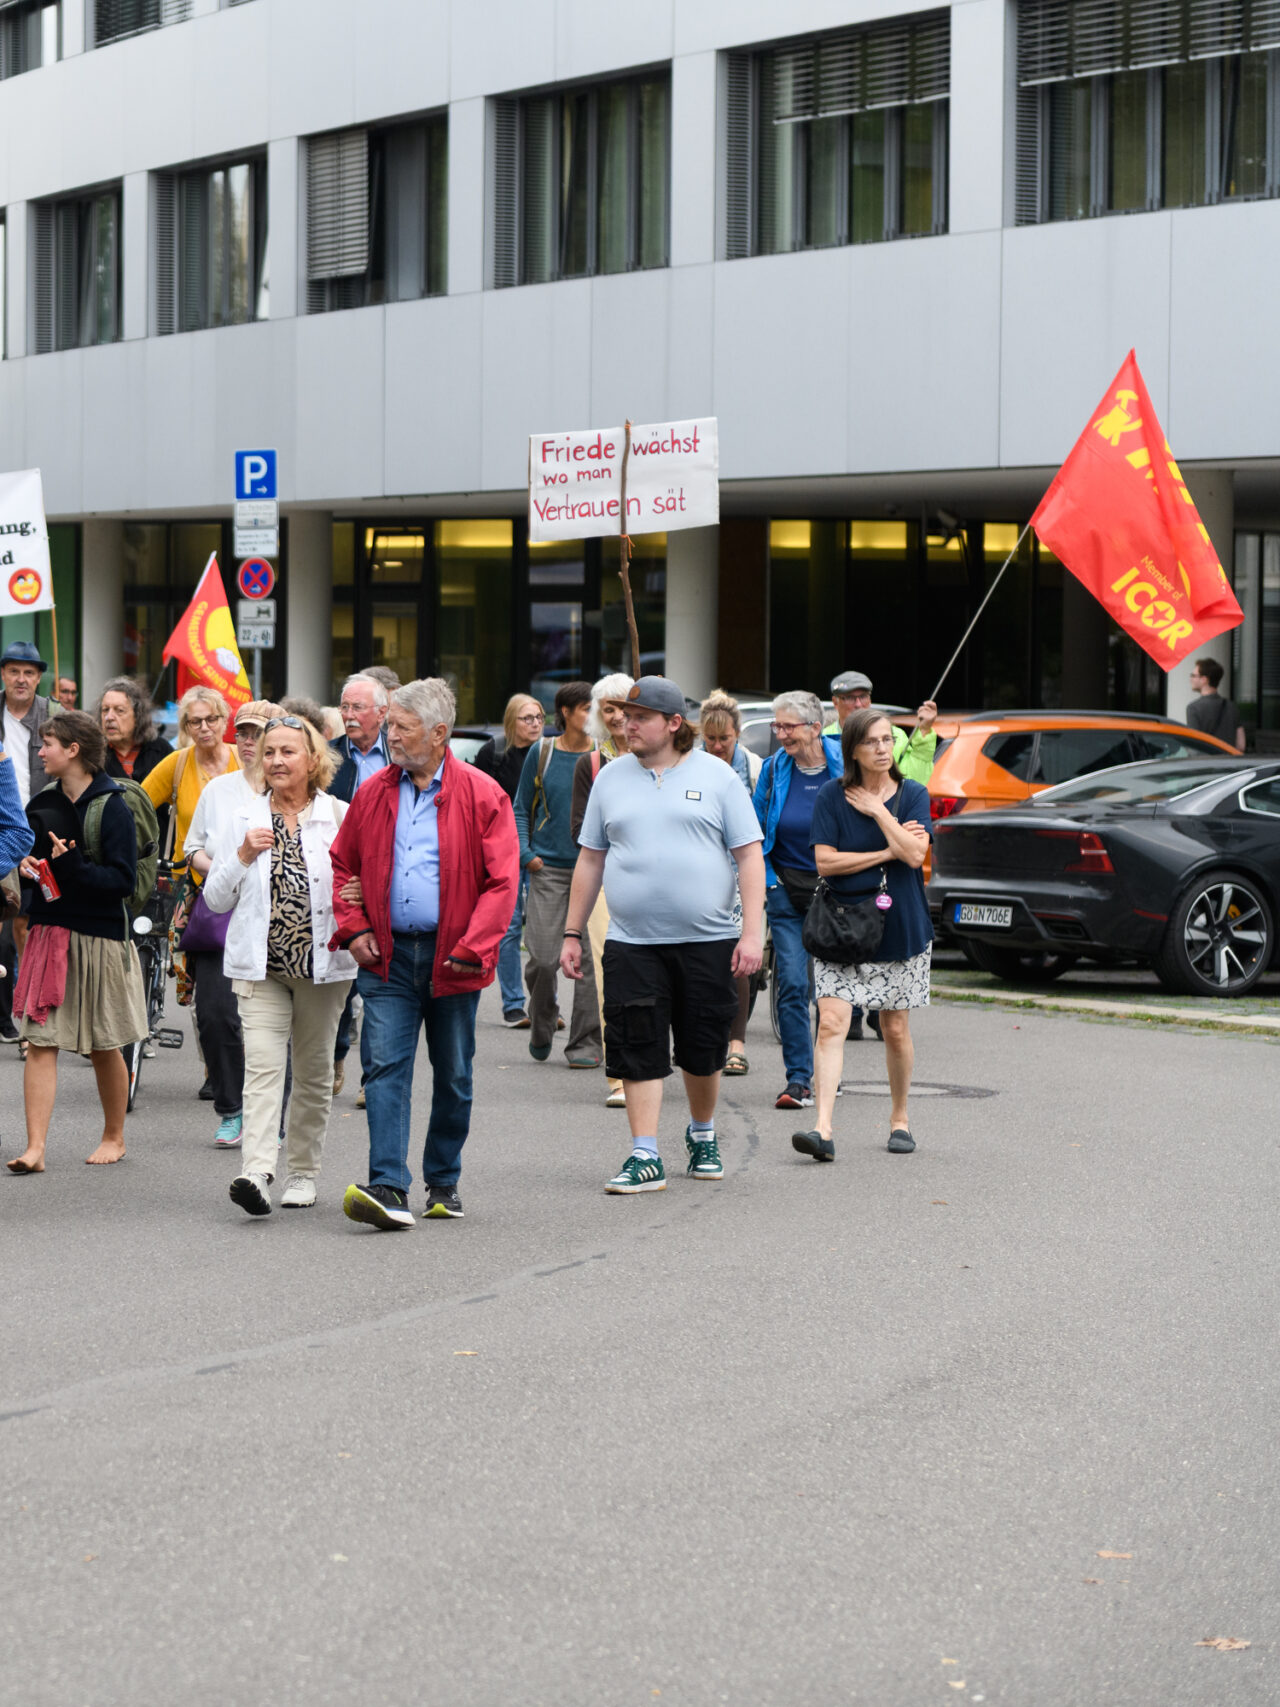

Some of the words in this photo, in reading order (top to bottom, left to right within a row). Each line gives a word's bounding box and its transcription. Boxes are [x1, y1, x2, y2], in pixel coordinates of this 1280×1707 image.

[541, 433, 616, 463] Friede
[632, 425, 701, 456] wächst
[243, 455, 268, 494] P
[543, 472, 568, 486] wo
[577, 467, 612, 482] man
[533, 493, 641, 522] Vertrauen
[652, 487, 687, 514] sät
[1140, 555, 1175, 593] Member
[1110, 566, 1194, 651] ICOR
[187, 600, 209, 668] GEMEINSAM
[202, 665, 229, 691] SIND
[227, 684, 251, 704] WIR
